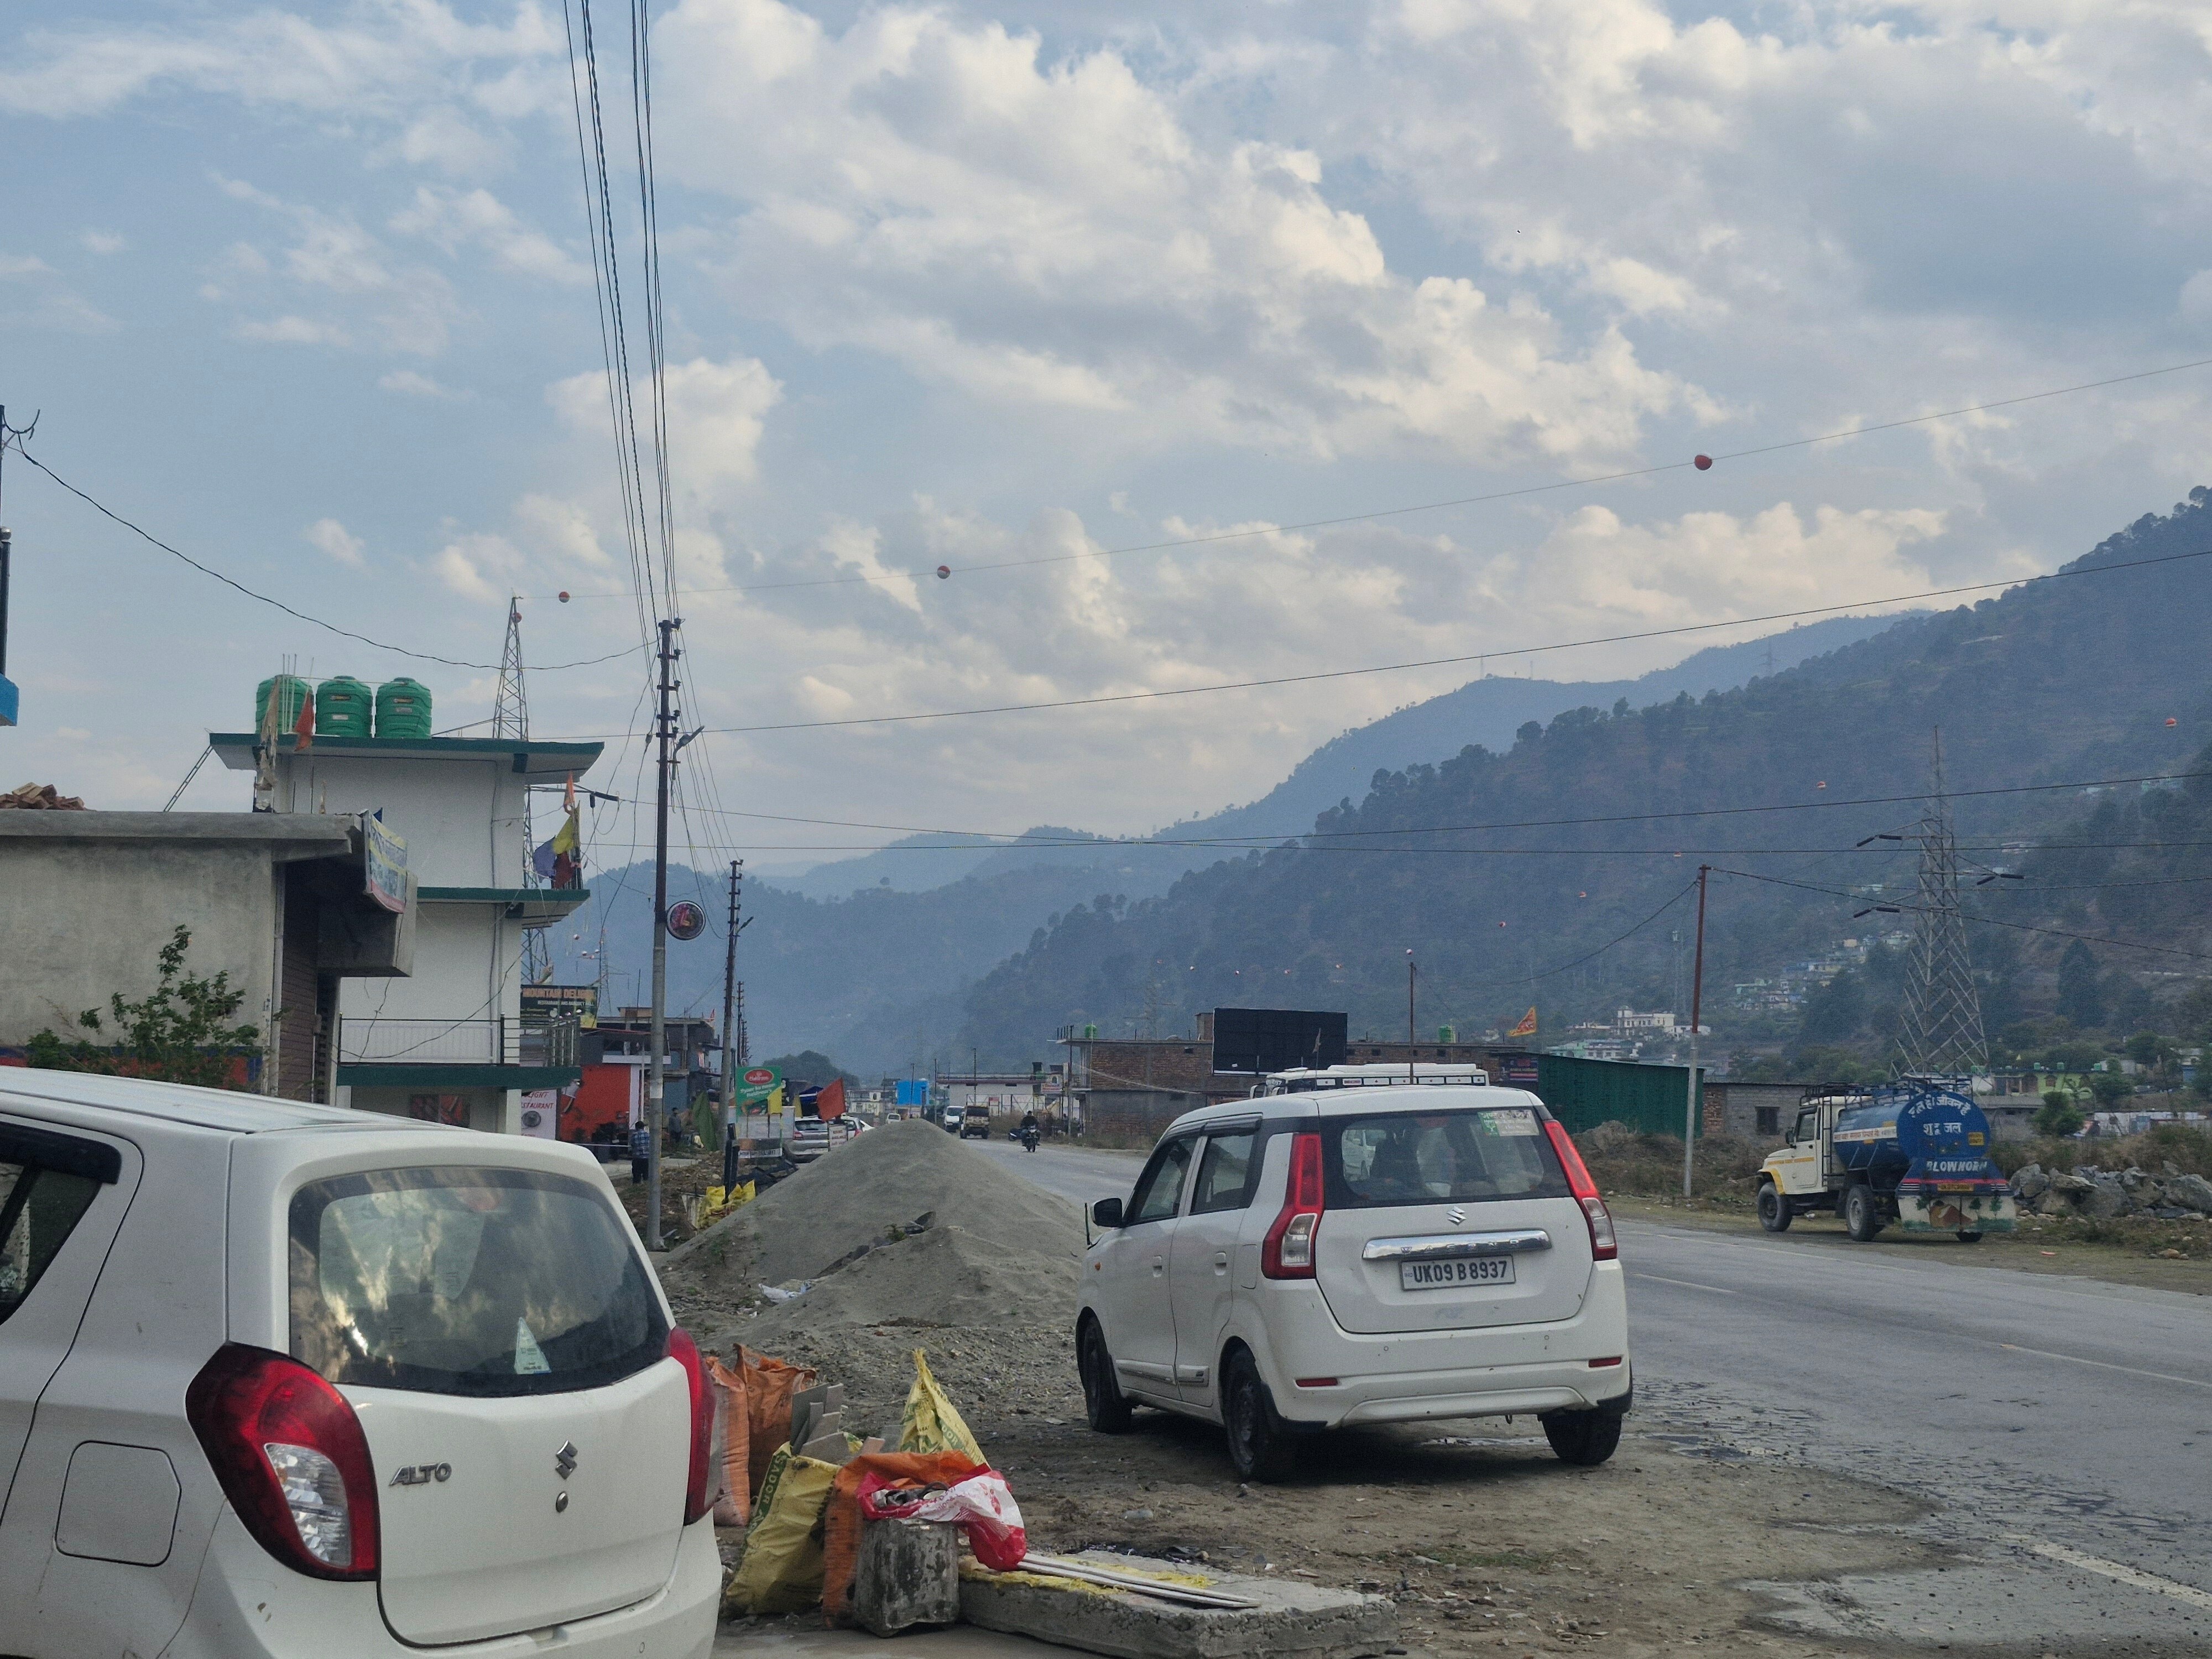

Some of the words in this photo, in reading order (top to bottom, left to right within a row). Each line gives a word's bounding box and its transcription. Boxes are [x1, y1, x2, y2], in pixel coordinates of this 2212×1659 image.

[1943, 1122, 1962, 1134] जल
[1413, 1263, 1453, 1284] UK09
[1457, 1262, 1467, 1281] B
[1469, 1260, 1507, 1280] 8937
[388, 1462, 452, 1486] ALTO
